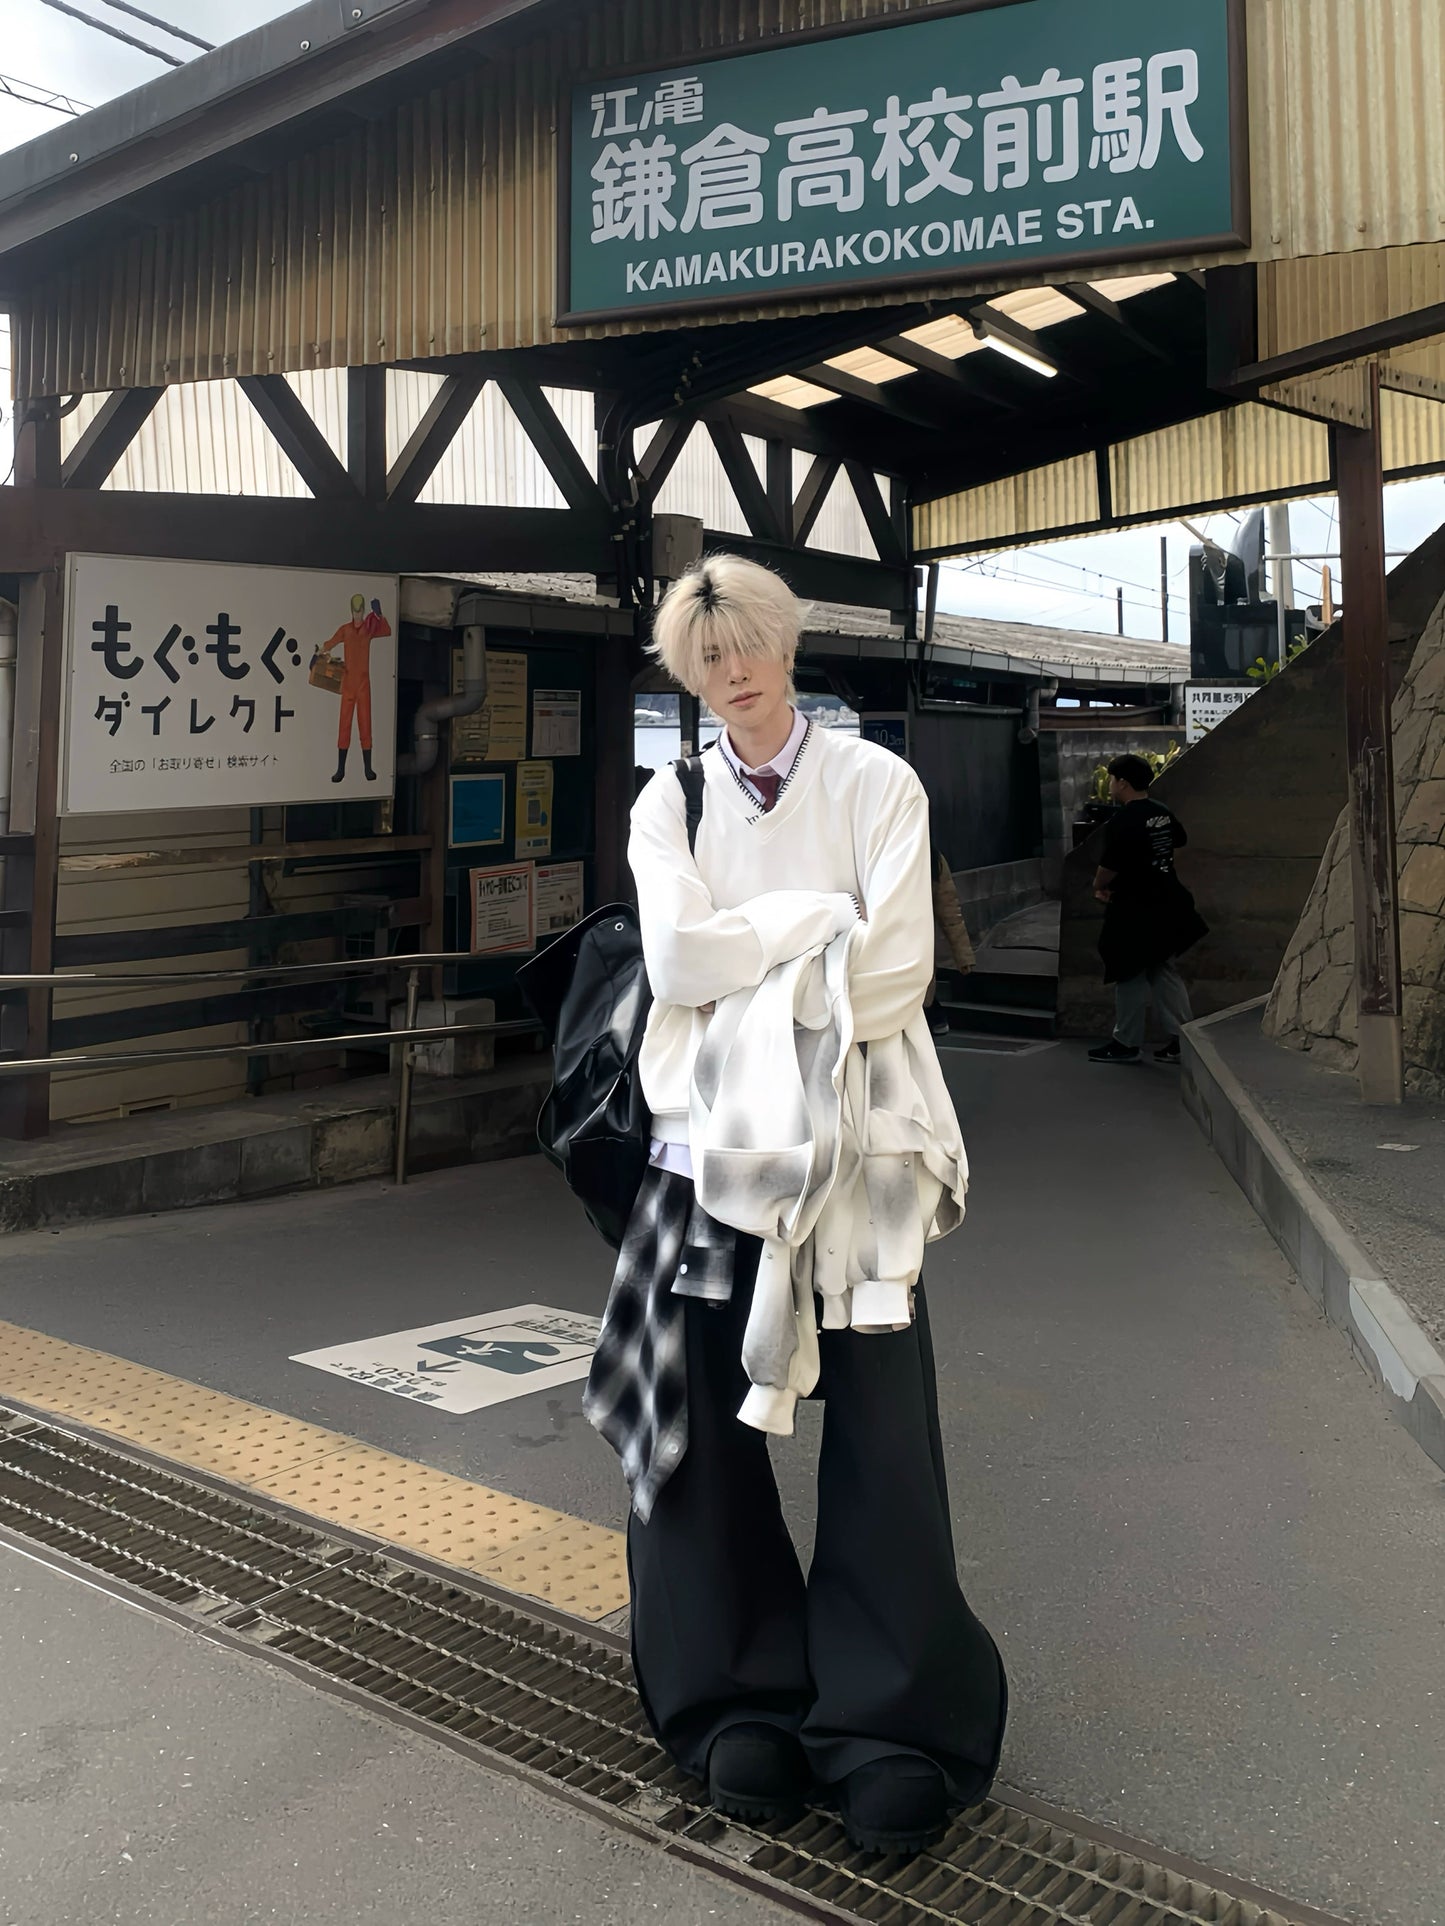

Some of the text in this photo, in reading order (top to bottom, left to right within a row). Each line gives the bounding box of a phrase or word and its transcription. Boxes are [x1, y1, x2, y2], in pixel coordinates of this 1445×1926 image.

[590, 48, 1205, 244] 鎌倉高校前駅
[625, 196, 1155, 294] KAMAKURAKOKOMAE STA.
[91, 604, 301, 684] もぐもぐ
[94, 691, 295, 737] ダイレクト
